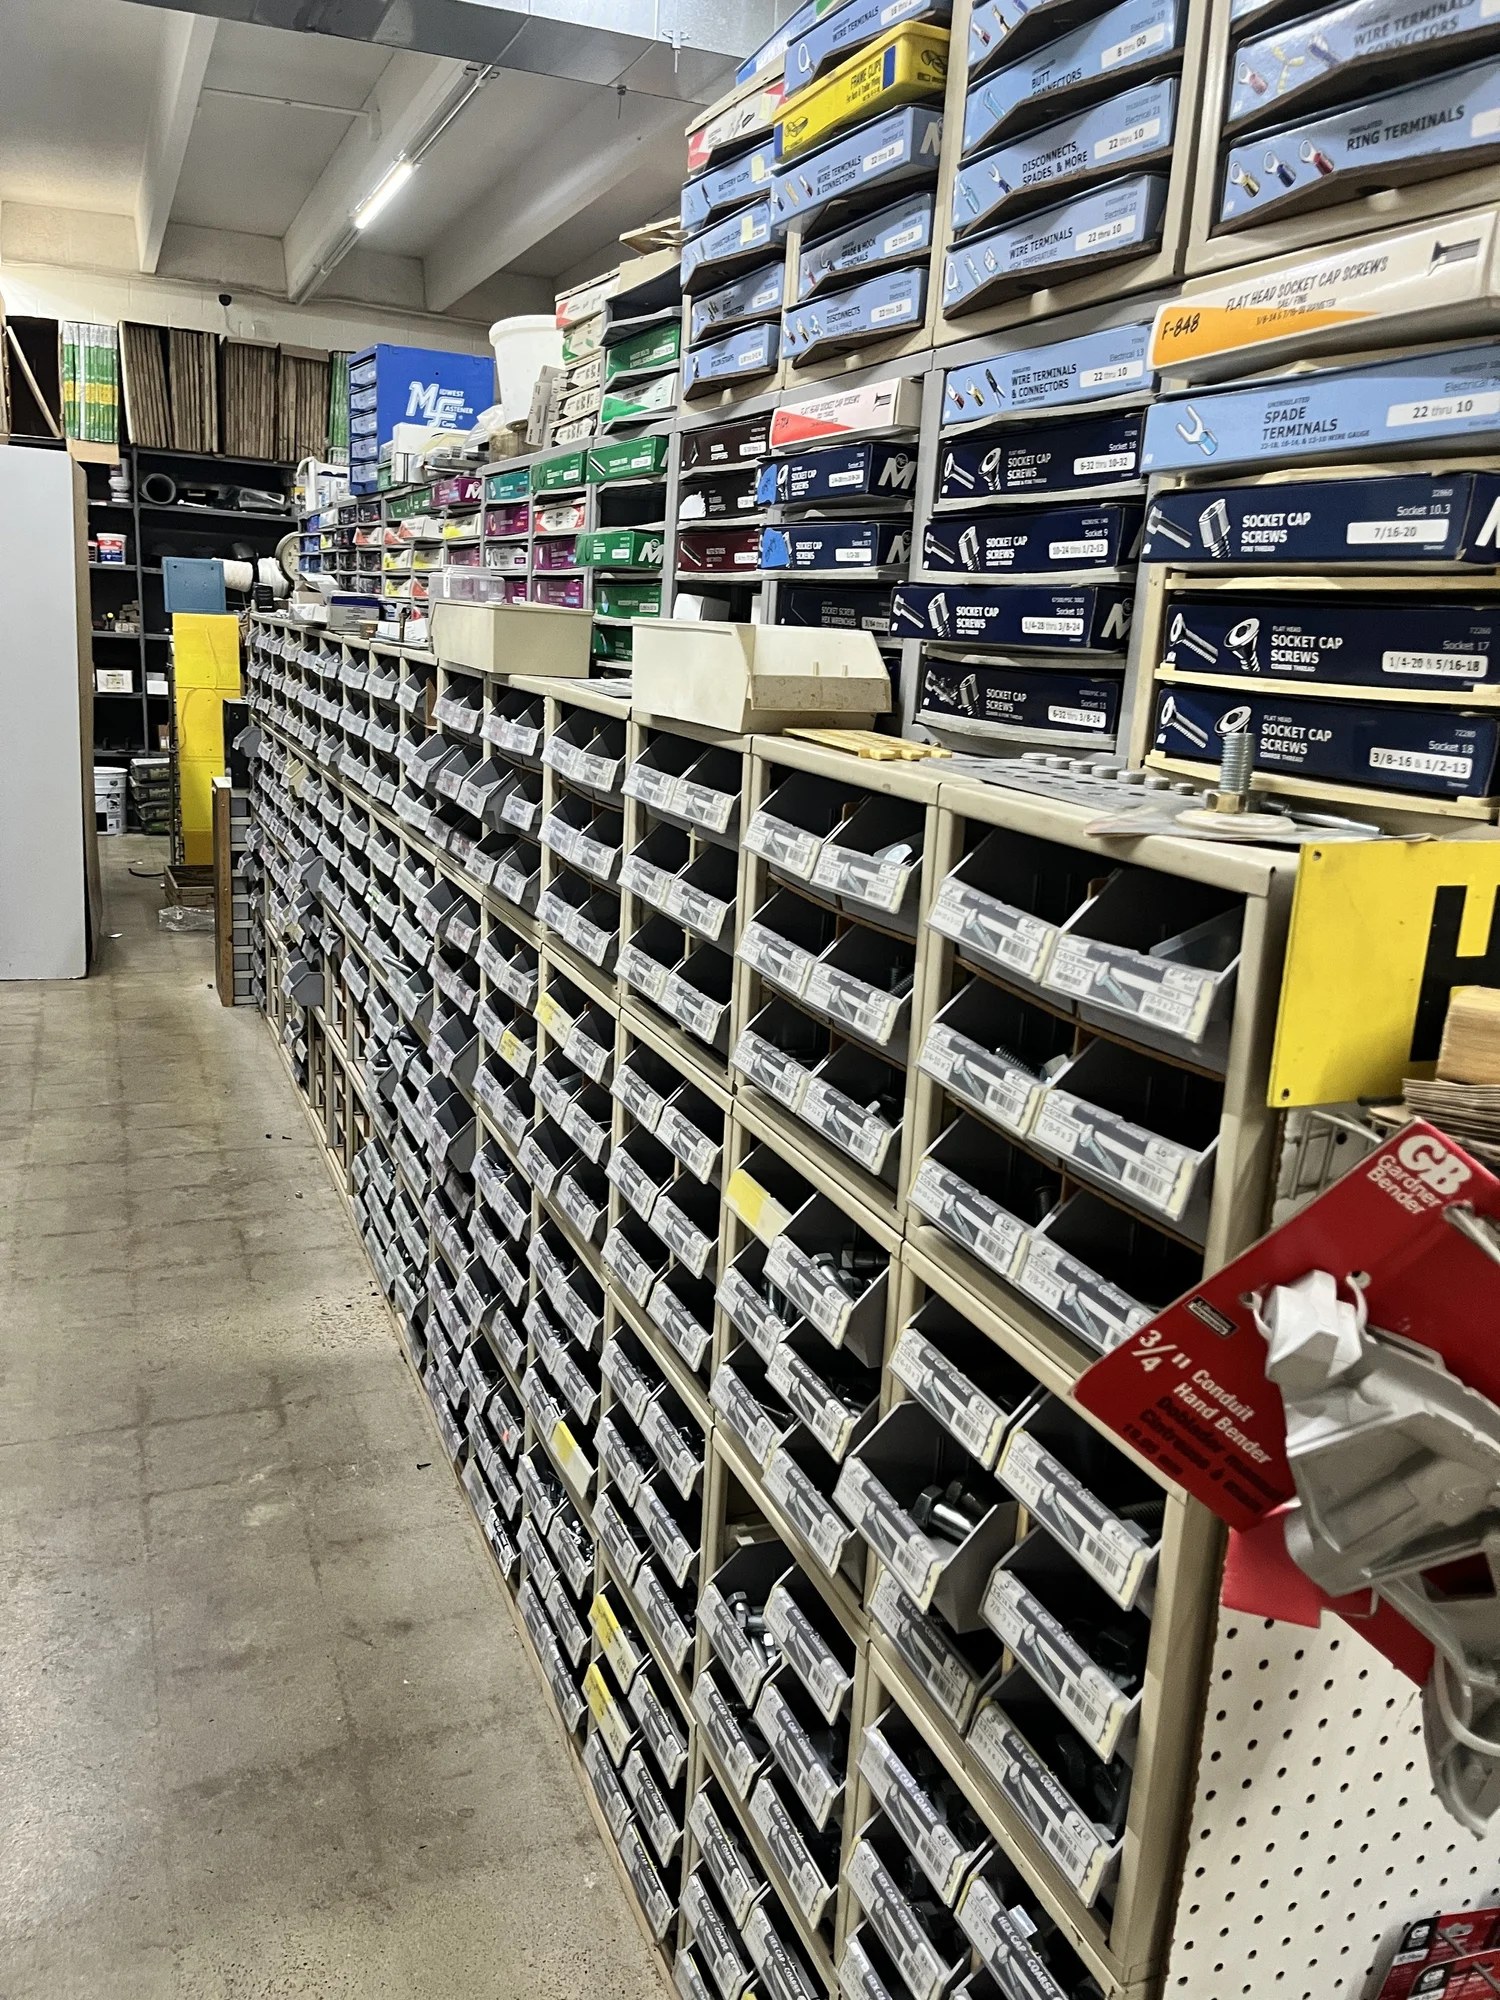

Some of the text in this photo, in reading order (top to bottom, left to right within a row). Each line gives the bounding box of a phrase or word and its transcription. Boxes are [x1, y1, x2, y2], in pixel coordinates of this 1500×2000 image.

[848, 5, 880, 33] TERMINALS
[1353, 22, 1390, 47] WIRE
[1031, 71, 1051, 89] BUTT
[1347, 105, 1464, 151] RING TERMINALS
[1108, 138, 1118, 150] 22
[1134, 128, 1144, 140] 10
[1065, 151, 1088, 169] MORE
[816, 155, 862, 185] WIRE TERMINALS
[822, 170, 856, 194] CONNECTORS
[1104, 206, 1126, 220] Electrical
[1087, 223, 1122, 243] 22 thru 10
[1009, 227, 1074, 260] WIRE TERMINALS
[1225, 256, 1389, 312] FLAT HEAD SOCKET CAP SCREWS
[827, 306, 860, 324] DISCONNECTS
[1161, 313, 1201, 340] F-848
[1109, 350, 1135, 362] Electrical
[1011, 363, 1077, 386] WIRE TERMINALS
[1094, 371, 1103, 382] 22
[1117, 367, 1128, 377] 10
[1011, 379, 1069, 399] & CONNECTORS
[1264, 407, 1306, 424] SPADE
[1412, 400, 1473, 419] 22 thru 10
[1262, 419, 1338, 440] TERMINALS
[1348, 430, 1369, 439] GAUGE
[1109, 441, 1137, 452] Socket 16
[1007, 452, 1051, 468] SOCKET CAP
[1108, 457, 1128, 468] 10-32
[1007, 467, 1037, 480] SCREWS
[1396, 504, 1451, 517] Socket 10.3
[1242, 512, 1311, 528] SOCKET CAP
[1084, 528, 1103, 538] Socket
[1241, 530, 1288, 544] SCREWS
[1374, 526, 1417, 539] 7/16-20
[986, 536, 1028, 548] SOCKET CAP
[986, 549, 1015, 560] SCREWS
[956, 607, 999, 617] SOCKET CAP
[1056, 607, 1084, 616] Socket 10
[956, 618, 986, 629] SCREWS
[1271, 635, 1343, 651] SOCKET CAP
[1443, 639, 1490, 651] Socket 17
[1270, 650, 1320, 664] SCREWS
[1388, 656, 1424, 670] 1/4-20
[1435, 659, 1480, 673] 5/16-18
[986, 688, 1027, 703] SOCKET CAP
[986, 700, 1014, 712] SCREWS
[1263, 714, 1292, 723] FLAT HEAD
[1261, 723, 1333, 742] SOCKET CAP
[1260, 738, 1308, 755] SCREWS
[1428, 740, 1474, 753] Socket 18
[1372, 752, 1412, 767] 3/8-16
[1424, 757, 1468, 774] 1/2-13
[1397, 1134, 1472, 1196] GB
[1376, 1154, 1442, 1208] Gardner
[1366, 1168, 1428, 1215] Bender
[1191, 1368, 1256, 1423] Conduit
[1173, 1382, 1273, 1465] Hand Bender
[780, 1709, 816, 1763] HEX CAP COARSE
[1009, 1732, 1068, 1810] HEX CAP COARSE
[889, 1758, 938, 1823] HEX CAP COARSE
[773, 1803, 806, 1860] HEX CAP COARSE
[876, 1873, 920, 1941] HEX CAP COARSE
[701, 1899, 729, 1951] HEX CAP COARSE
[768, 1935, 801, 1994] HEX CAP COARSE
[997, 1915, 1055, 1997] HEX CAP COARSE
